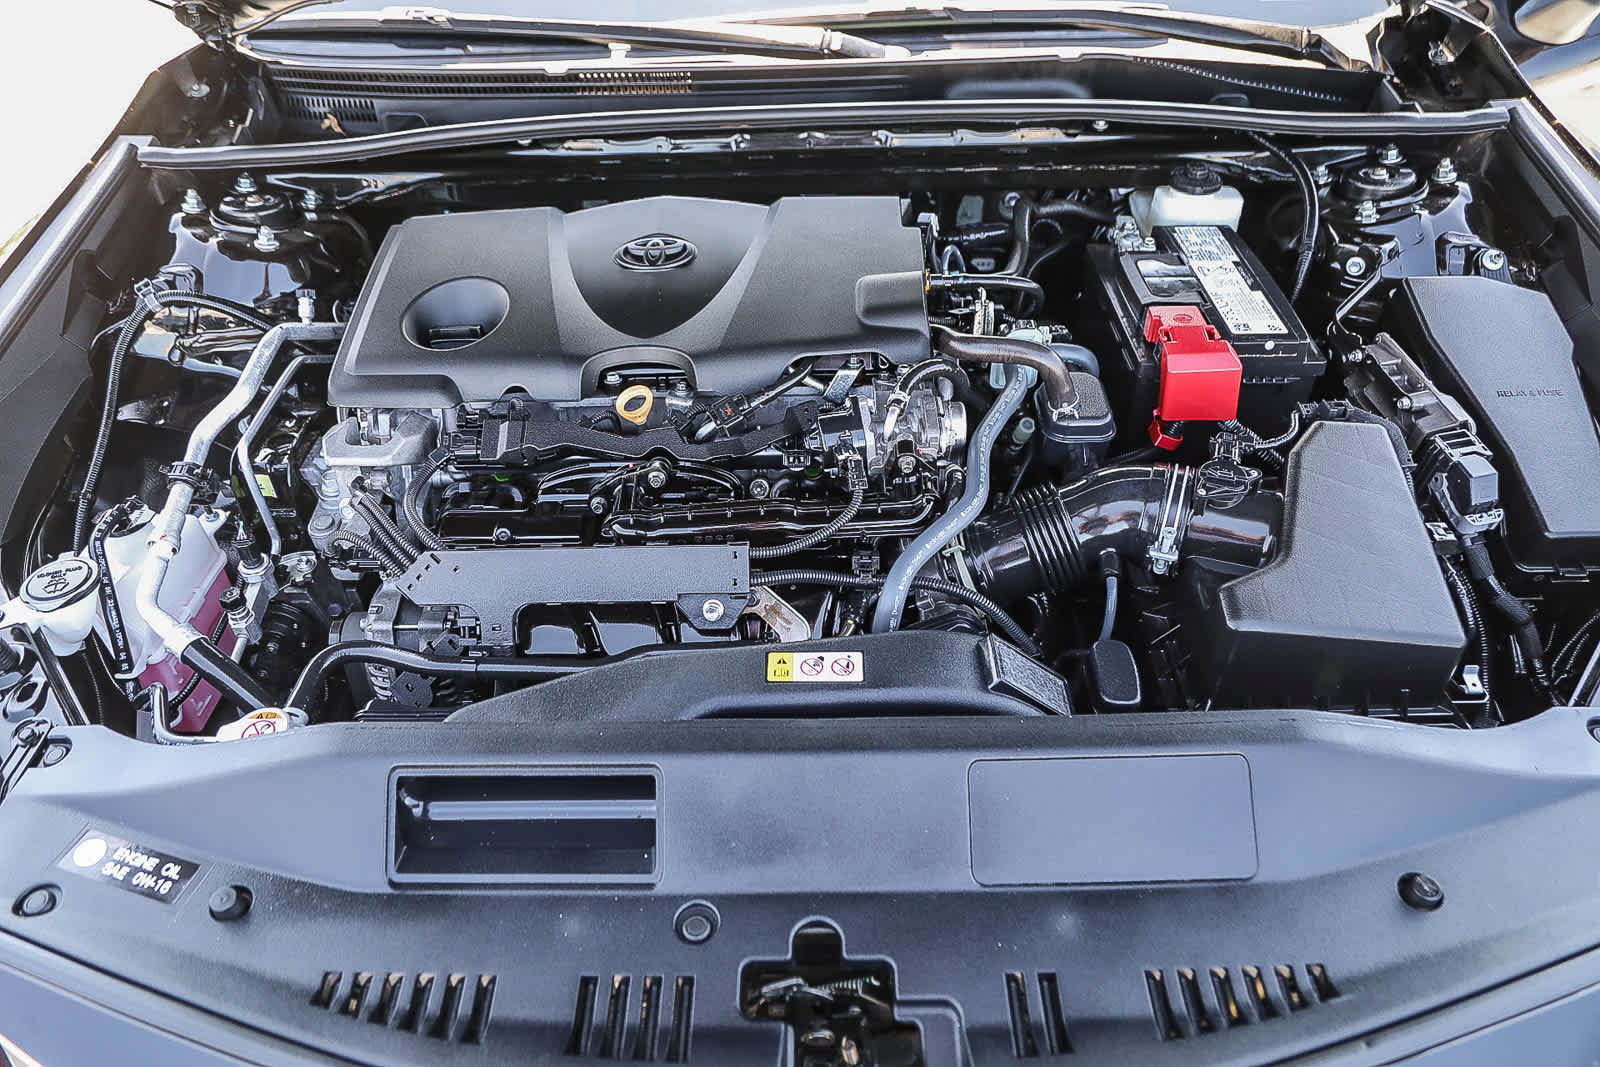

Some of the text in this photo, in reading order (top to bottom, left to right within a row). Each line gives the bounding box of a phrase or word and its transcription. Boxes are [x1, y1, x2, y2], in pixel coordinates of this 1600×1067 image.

[101, 861, 131, 881] SAE
[112, 847, 182, 880] ENGINE OIL
